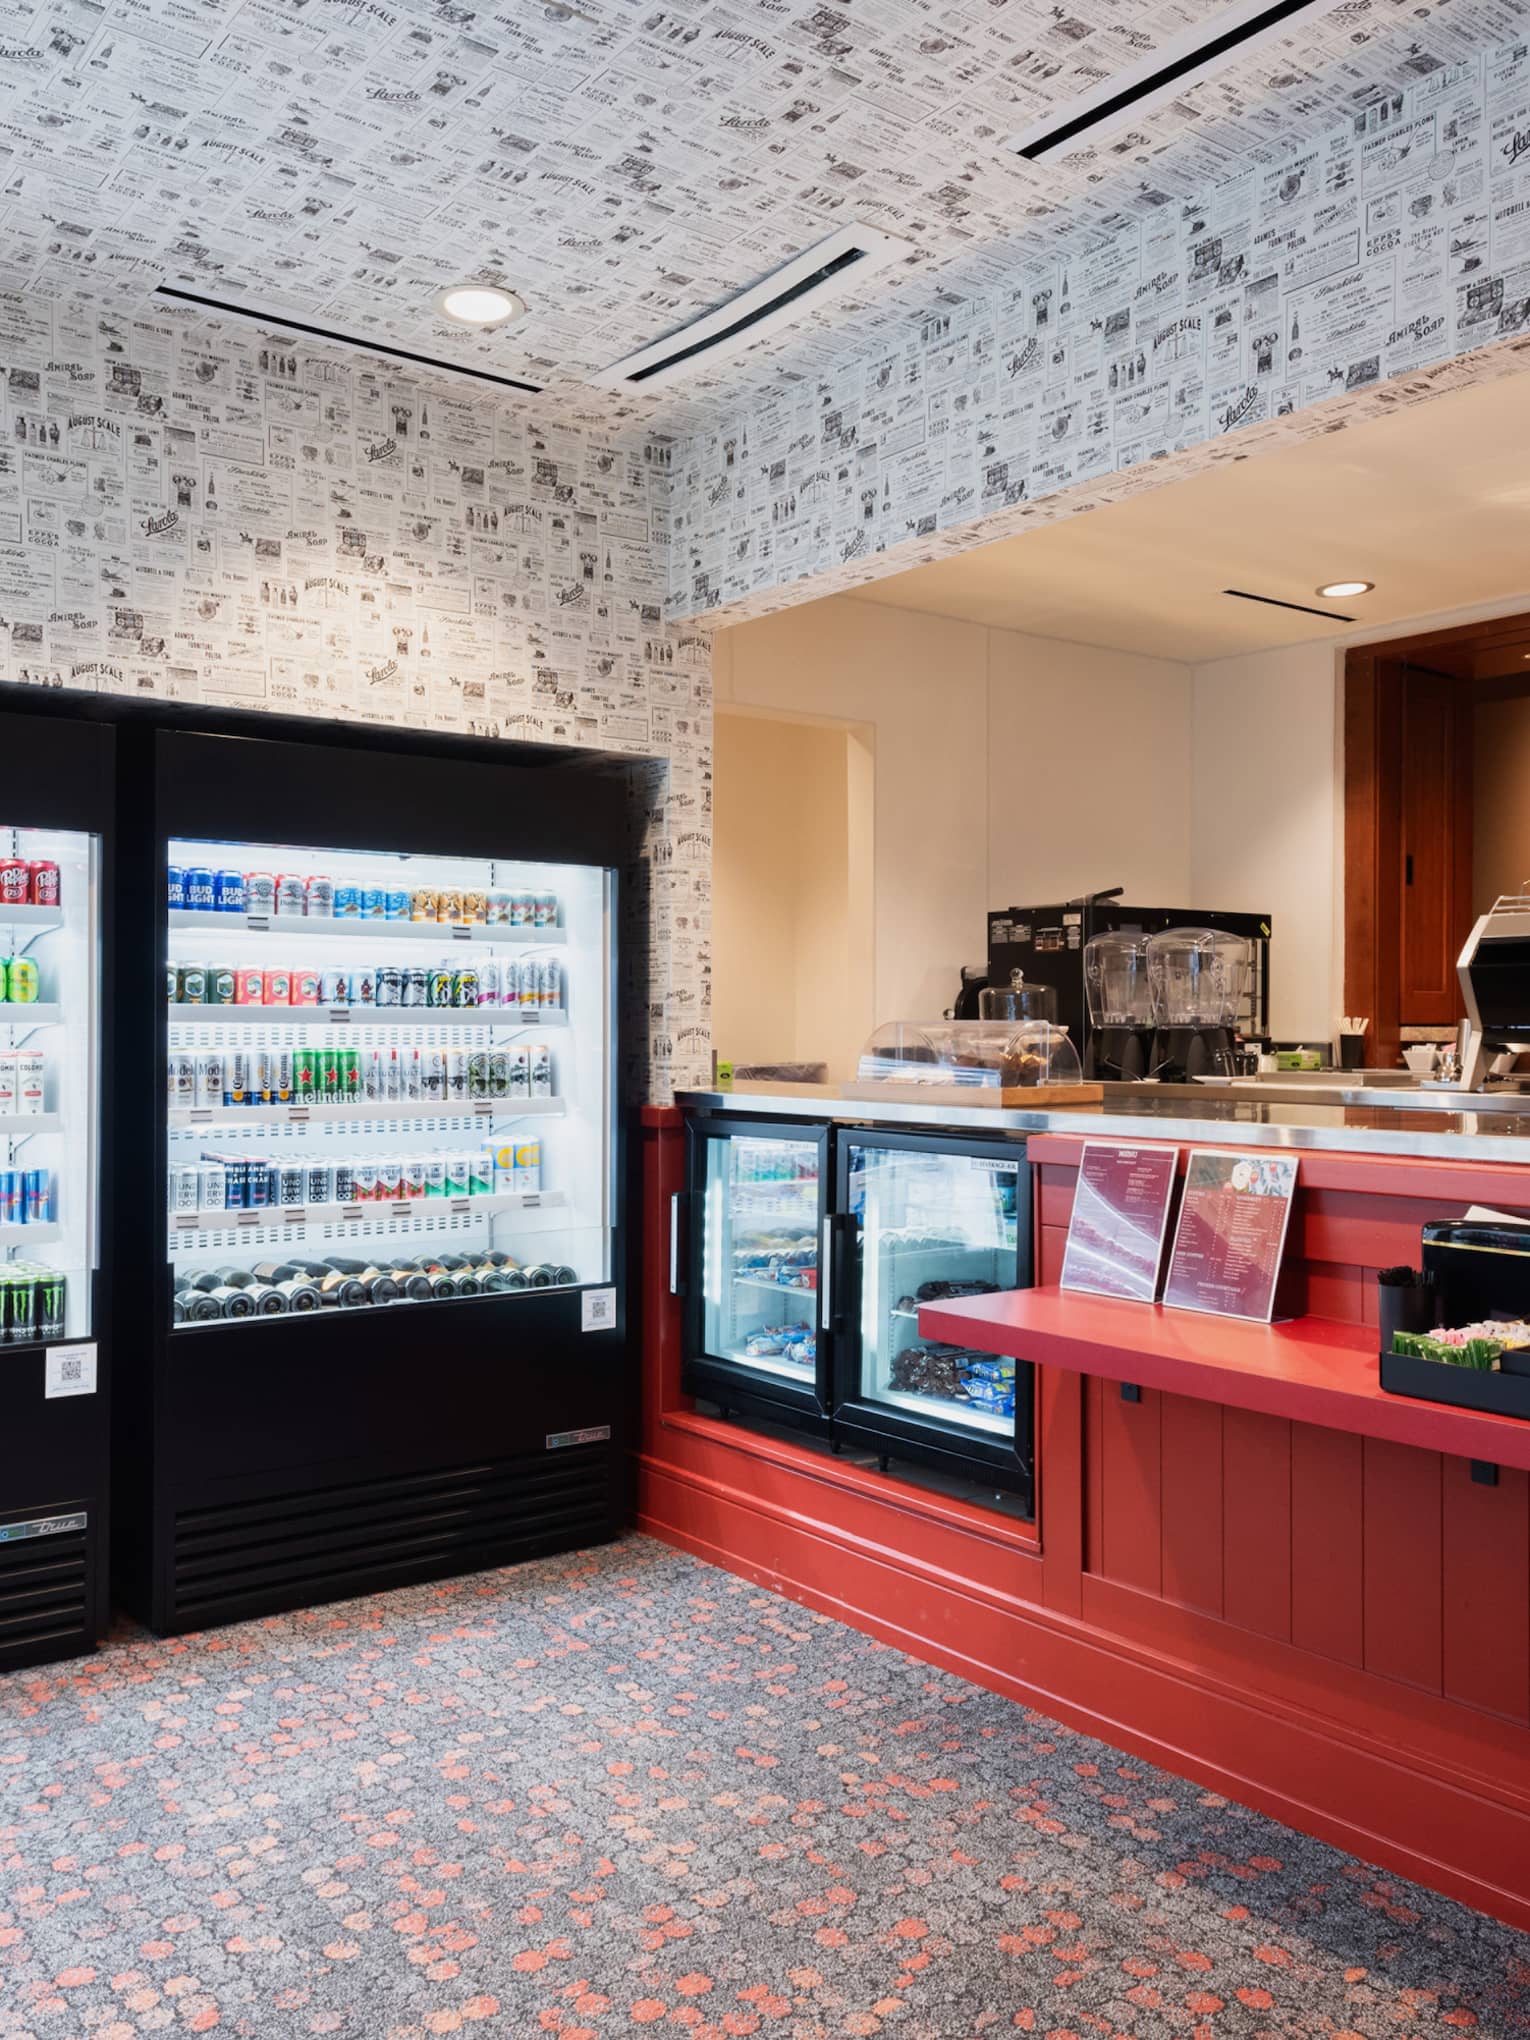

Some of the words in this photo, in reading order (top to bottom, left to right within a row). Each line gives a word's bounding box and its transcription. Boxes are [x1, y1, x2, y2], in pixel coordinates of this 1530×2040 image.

[366, 4, 397, 27] SCALE
[757, 0, 792, 14] SOAP
[712, 30, 752, 44] AUGUST
[750, 38, 776, 59] SCALE
[1128, 38, 1157, 52] SOAP
[365, 87, 422, 103] Larola
[1388, 124, 1413, 142] CHARLES
[201, 140, 240, 152] AUGUST
[238, 147, 266, 164] SCALE
[1314, 205, 1336, 219] PIANOS
[1288, 235, 1306, 250] POLISH
[1366, 228, 1402, 248] EPPS'S
[1366, 238, 1402, 258] COCOA
[1134, 272, 1168, 300] AMIRAL
[1156, 272, 1179, 294] SOAP
[1153, 320, 1178, 352] AUGUST
[1180, 318, 1202, 332] SCALE
[1386, 314, 1430, 347] AMIRAL
[1414, 316, 1445, 342] SOAP
[45, 362, 83, 373] AMIRAL
[70, 372, 96, 382] SOAP
[1218, 382, 1259, 433] Larola
[68, 415, 96, 430] AUGUST
[96, 418, 121, 438] SCALE
[504, 504, 525, 517] AUGUST
[525, 504, 543, 522] SCALE
[139, 508, 179, 538] Larola
[28, 536, 60, 548] COCOA
[304, 576, 328, 590] AUGUST
[329, 576, 350, 596] SCALE
[48, 612, 86, 623] AMIRAL
[72, 620, 98, 630] SOAP
[70, 662, 99, 678] AUGUST
[100, 664, 124, 682] SCALE
[168, 884, 183, 894] UD
[189, 886, 213, 896] BUD
[222, 887, 244, 898] BUD
[186, 894, 215, 906] LIGHT
[695, 1026, 712, 1041] SCALE
